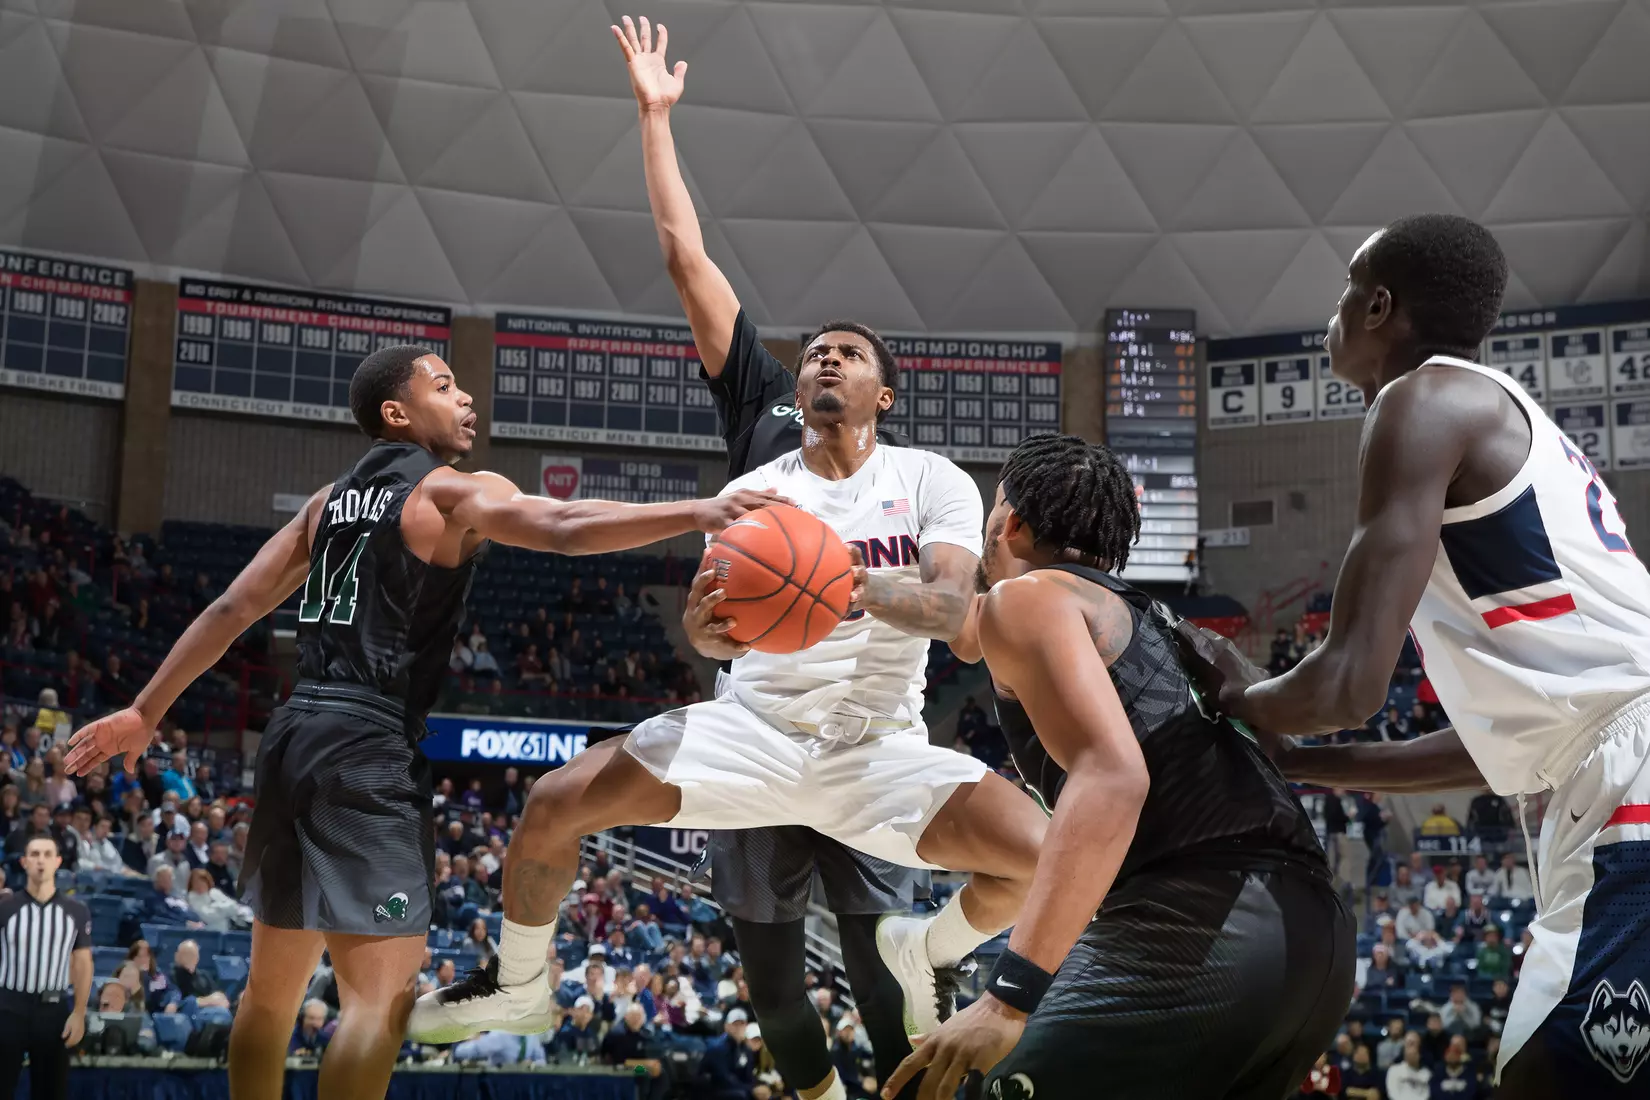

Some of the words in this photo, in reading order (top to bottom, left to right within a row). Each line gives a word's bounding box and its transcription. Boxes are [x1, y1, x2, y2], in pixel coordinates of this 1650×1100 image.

[21, 276, 124, 301] CHAMPIONS
[205, 301, 318, 325] TOURNAMENT
[328, 316, 426, 337] CHAMPIONS
[373, 305, 446, 324] CONFERENCE
[507, 318, 573, 333] NATIONAL
[577, 323, 652, 339] INVITATION
[567, 337, 686, 356] APPEARANCES
[886, 340, 1048, 359] CHAMPIONSHIP
[538, 351, 565, 370] 1974
[931, 358, 1050, 373] APPEARANCES
[16, 374, 115, 396] BASKETBALL
[179, 394, 284, 414] CONNECTICUT
[1222, 390, 1244, 414] C
[1281, 386, 1295, 409] 9
[498, 424, 600, 439] CONNECTICUT
[548, 473, 575, 486] NIT
[328, 486, 393, 525] THOMAS
[299, 532, 371, 625] 14
[671, 829, 709, 856] UC
[1448, 835, 1482, 853] 114
